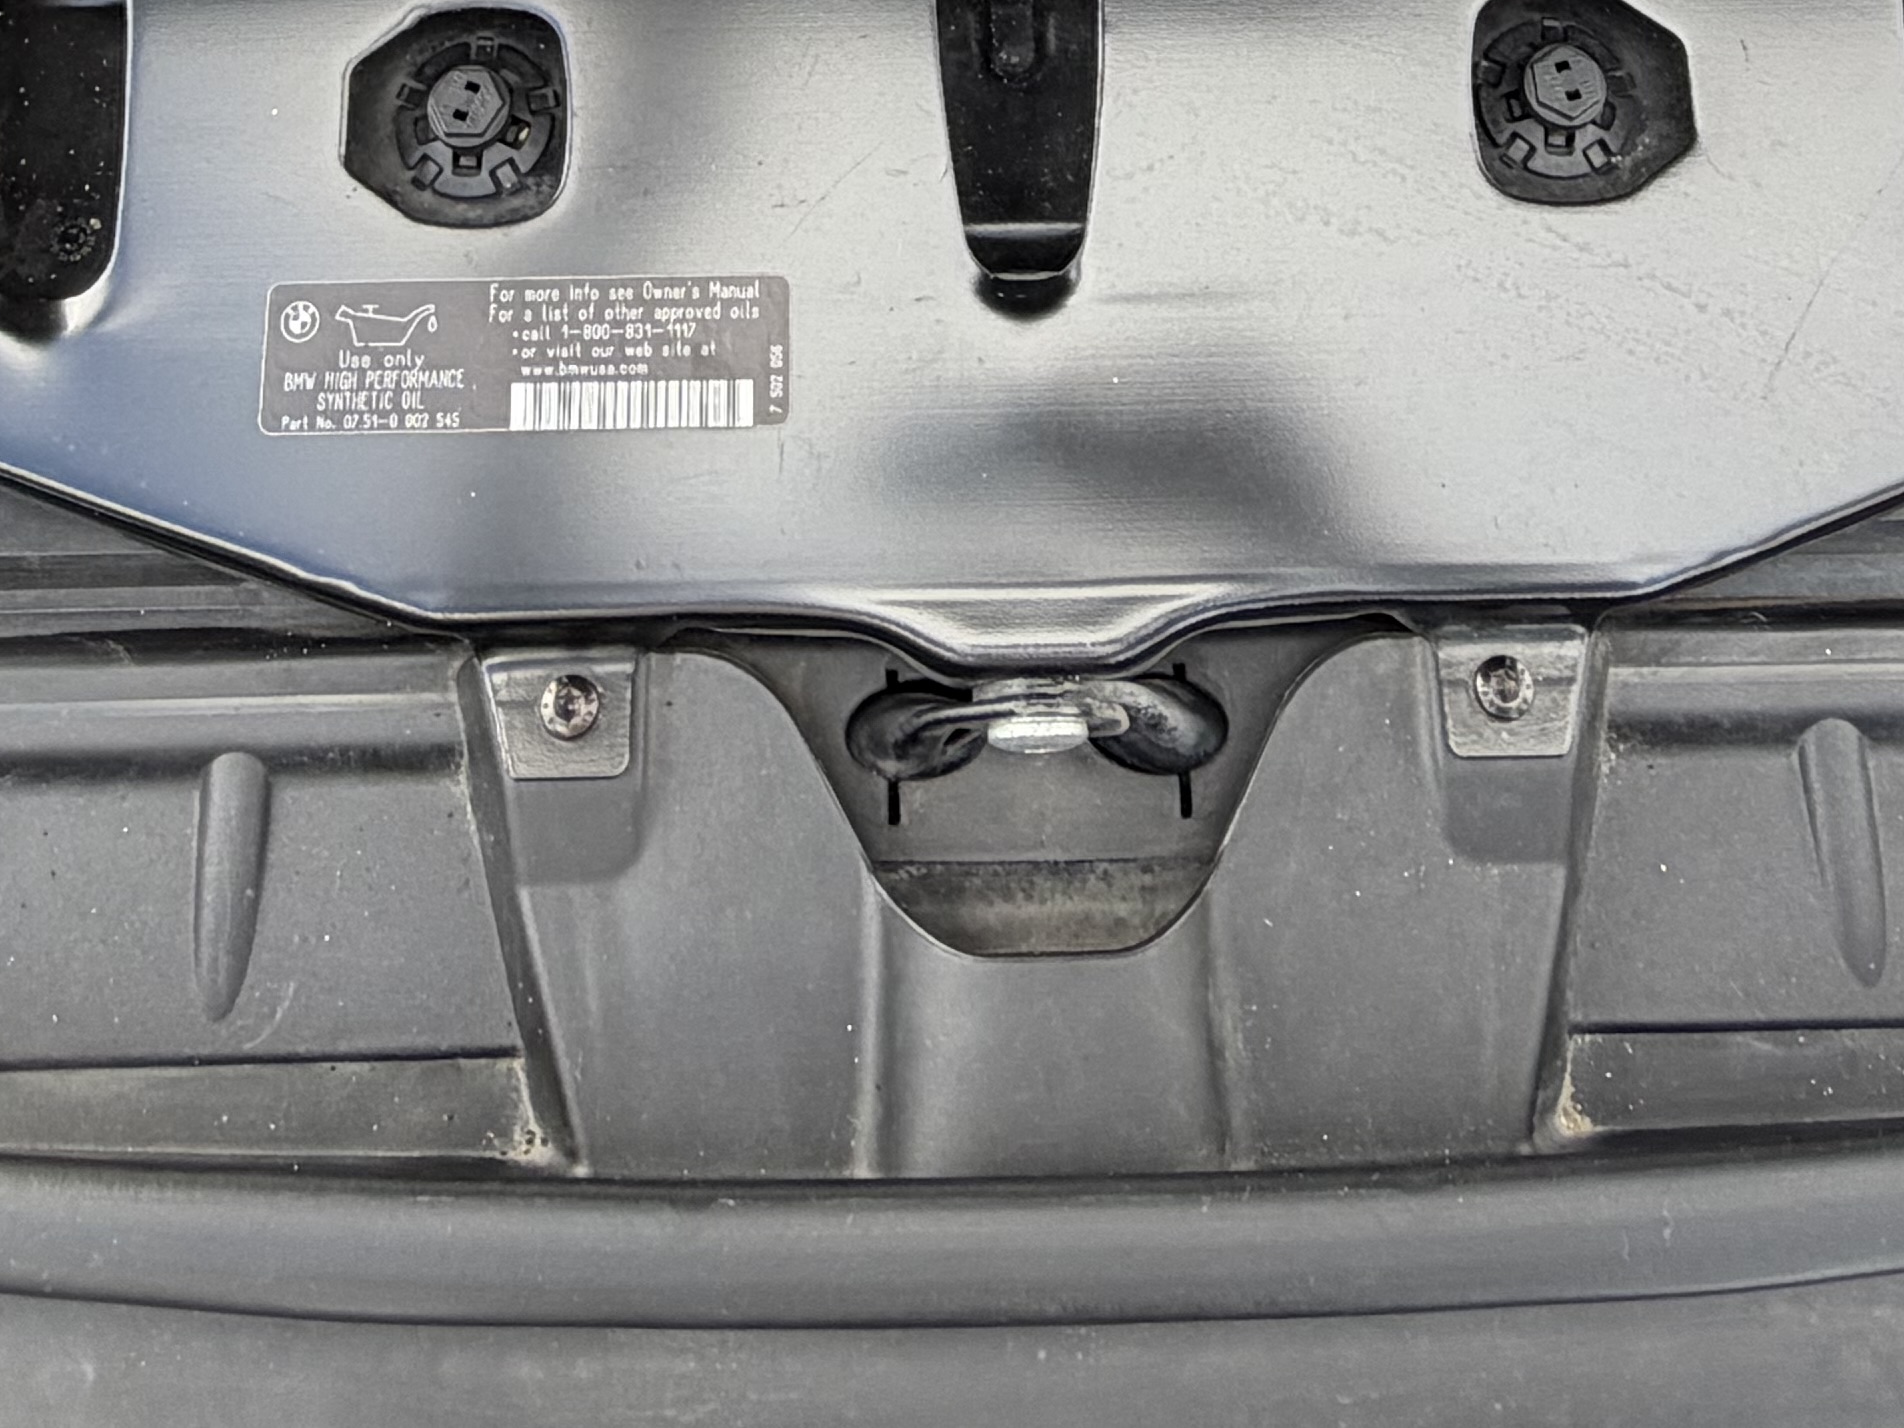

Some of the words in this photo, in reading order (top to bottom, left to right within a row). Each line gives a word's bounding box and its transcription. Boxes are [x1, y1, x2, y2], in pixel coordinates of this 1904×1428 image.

[489, 283, 515, 302] For
[524, 288, 560, 302] more
[608, 287, 634, 301] see
[642, 280, 700, 300] Owner's
[708, 279, 760, 299] Manual
[488, 303, 514, 323] For
[523, 309, 532, 322] a
[542, 303, 569, 322] list
[578, 302, 595, 321] of
[604, 301, 644, 321] other
[654, 300, 721, 322] approved
[730, 300, 760, 320] oils
[561, 322, 696, 340] 1-800-831-1117
[546, 342, 581, 358] visit
[591, 346, 615, 358] our
[624, 341, 653, 357] web
[661, 340, 692, 357] site
[700, 340, 716, 357] at
[338, 349, 371, 369] Use
[383, 348, 425, 372] only
[520, 360, 649, 376] www.bmwusa.com
[283, 371, 317, 392] BMW
[324, 370, 358, 390] HIGH
[365, 368, 465, 390] PERFORMANCE
[316, 391, 394, 412] SYNTHETIC
[401, 391, 425, 410] OIL
[281, 415, 308, 430] Part
[316, 415, 337, 430] No.
